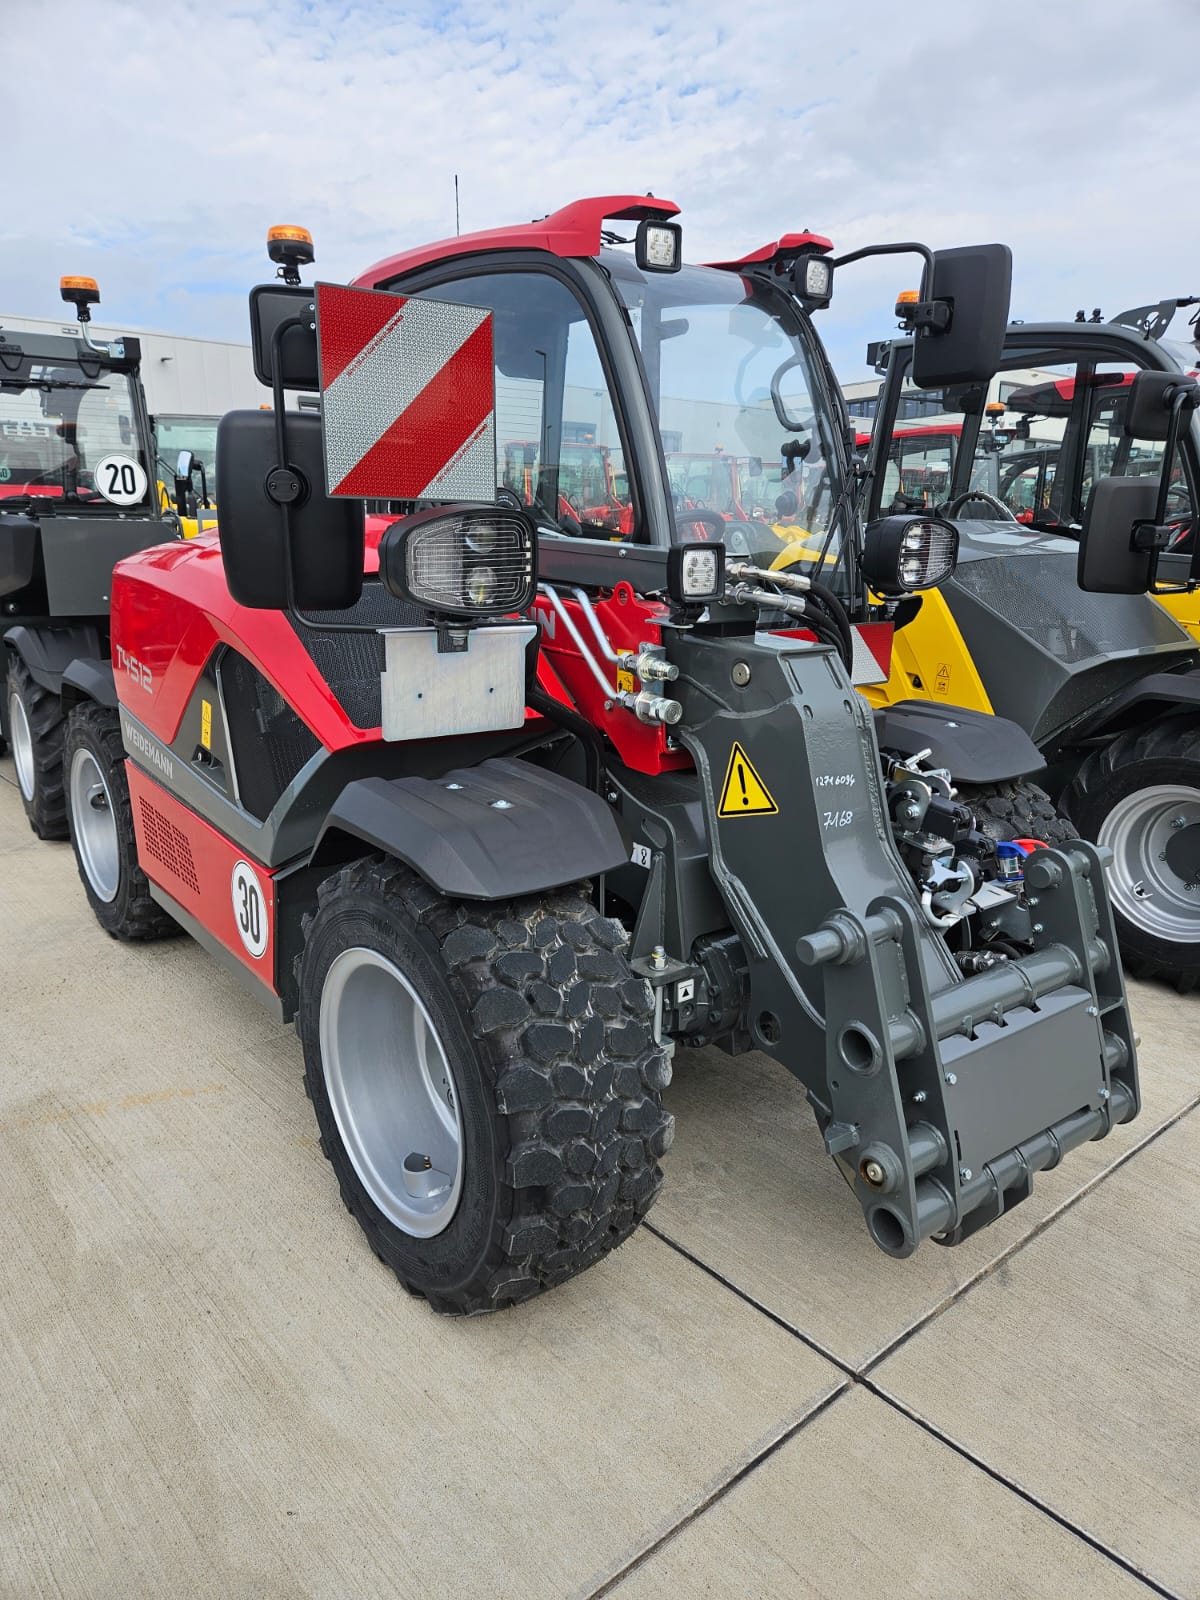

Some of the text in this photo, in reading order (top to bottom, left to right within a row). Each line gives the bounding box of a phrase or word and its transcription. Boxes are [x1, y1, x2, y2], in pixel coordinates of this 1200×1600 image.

[105, 463, 136, 495] 20
[116, 644, 153, 695] T4512
[125, 721, 174, 779] WEIDEMANN
[823, 810, 853, 830] 7168
[238, 875, 260, 944] 30
